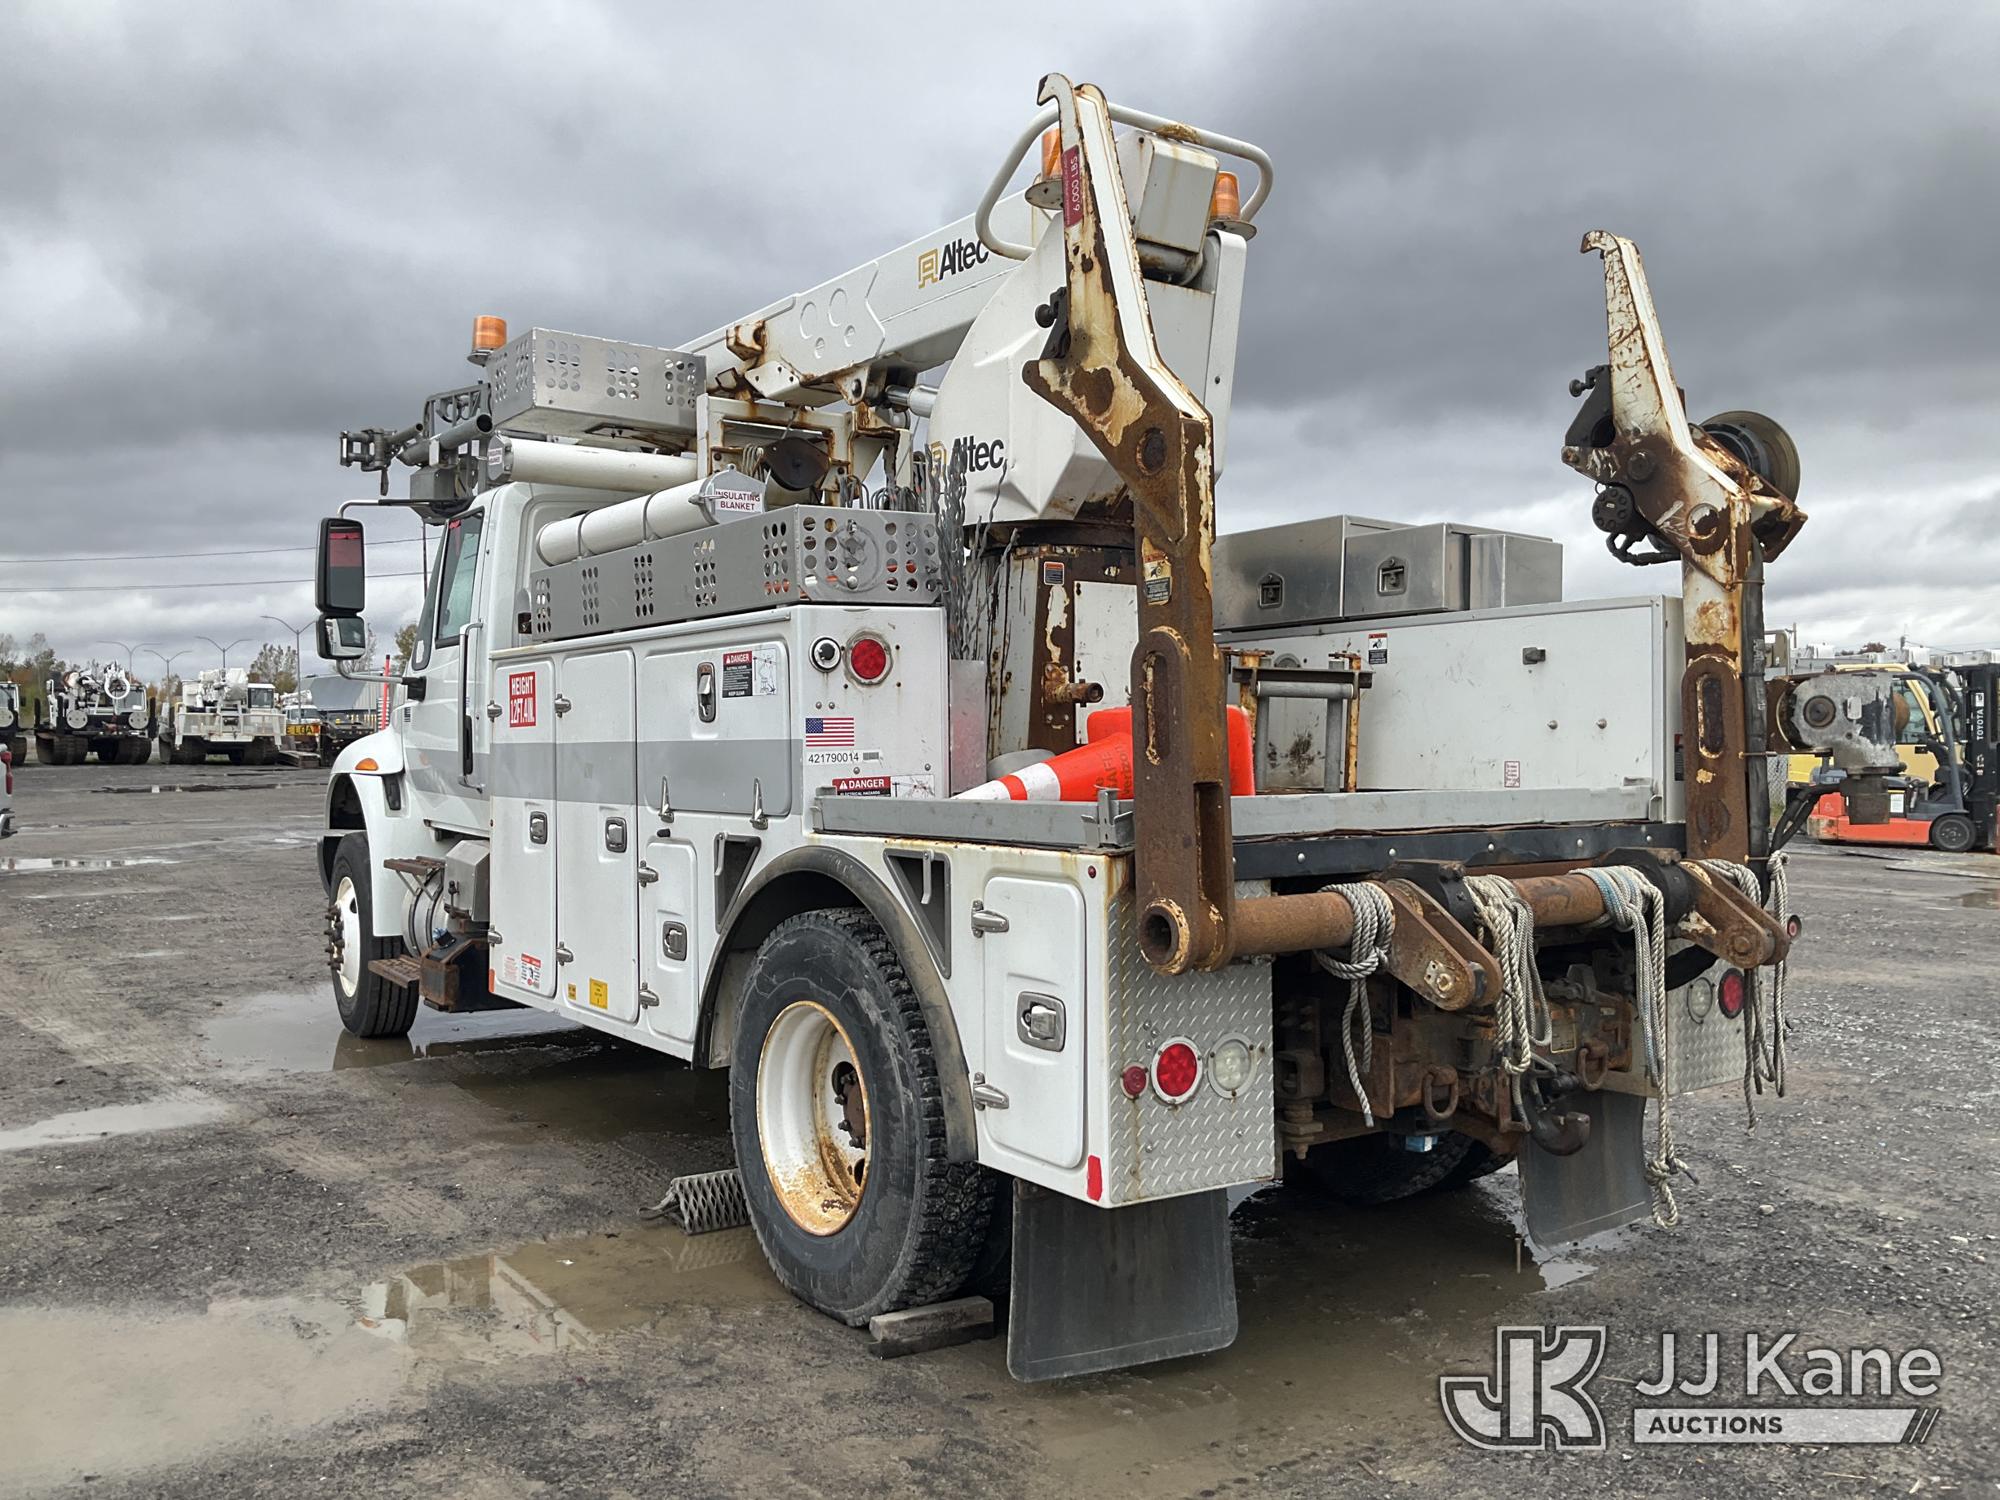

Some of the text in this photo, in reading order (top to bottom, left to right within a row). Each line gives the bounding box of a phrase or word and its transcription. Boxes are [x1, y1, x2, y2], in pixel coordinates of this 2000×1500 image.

[1070, 156, 1079, 177] LBS
[939, 238, 989, 280] Altec
[720, 501, 755, 510] BLANKET
[730, 653, 750, 663] DANGER
[511, 676, 533, 695] HEIGHT
[1976, 708, 1984, 740] TOYOTA
[808, 752, 859, 763] 421790014
[849, 779, 885, 789] DANGER
